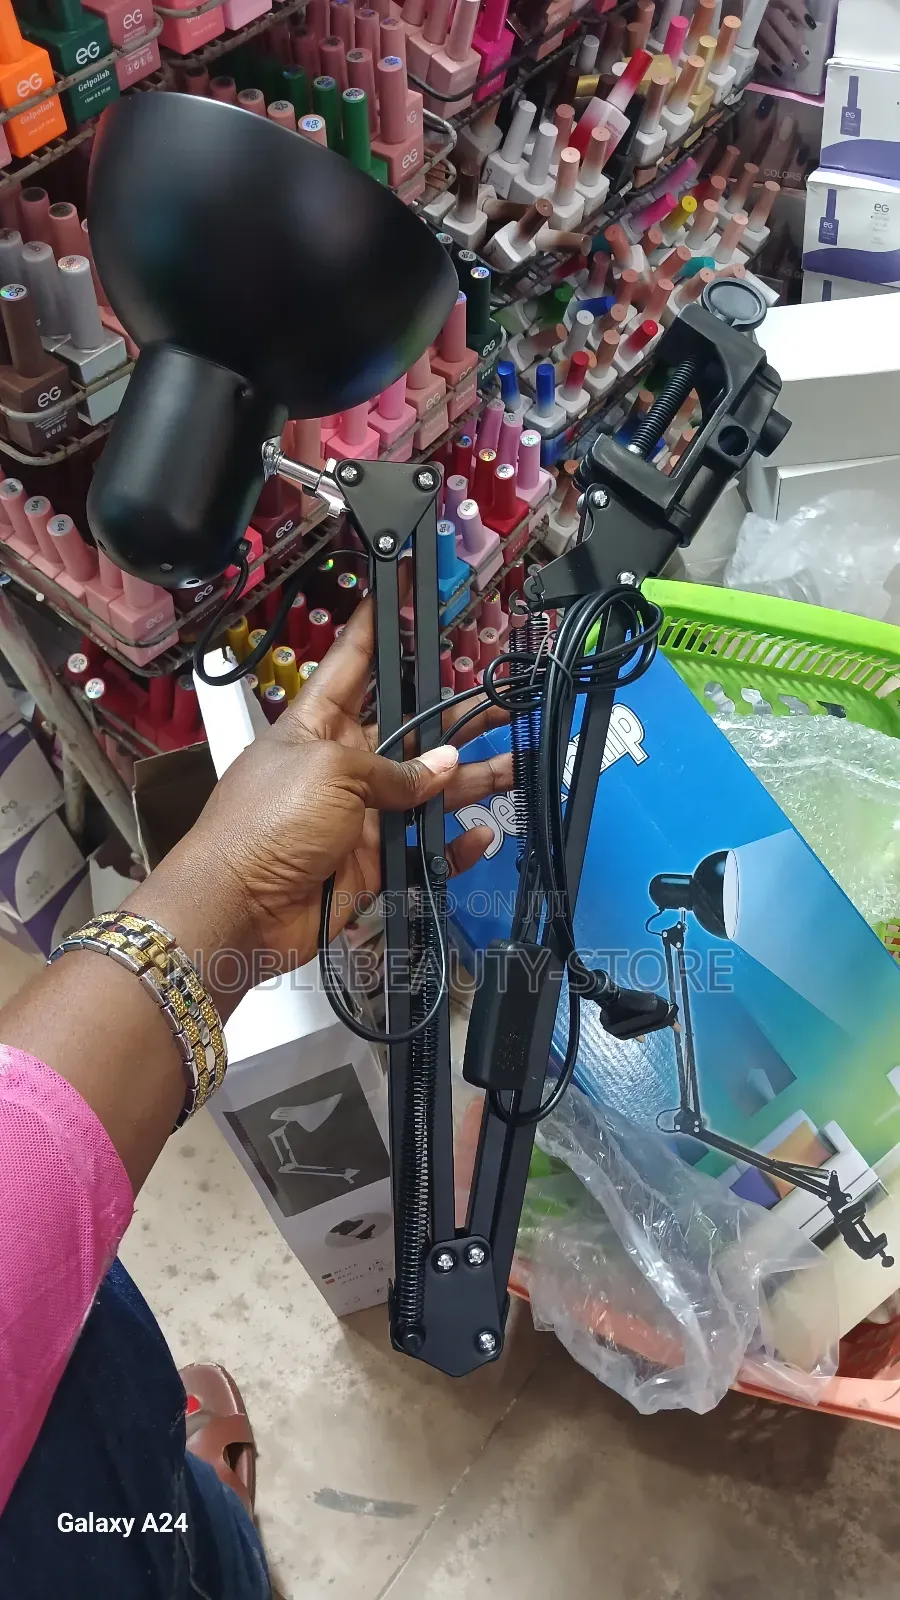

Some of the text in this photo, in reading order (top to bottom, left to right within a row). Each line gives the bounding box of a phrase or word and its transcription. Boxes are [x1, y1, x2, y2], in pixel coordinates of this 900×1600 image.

[75, 41, 100, 65] eG
[17, 72, 43, 98] eG
[78, 69, 111, 92] Gelpolish
[763, 168, 802, 181] COLORS
[38, 386, 62, 408] eG
